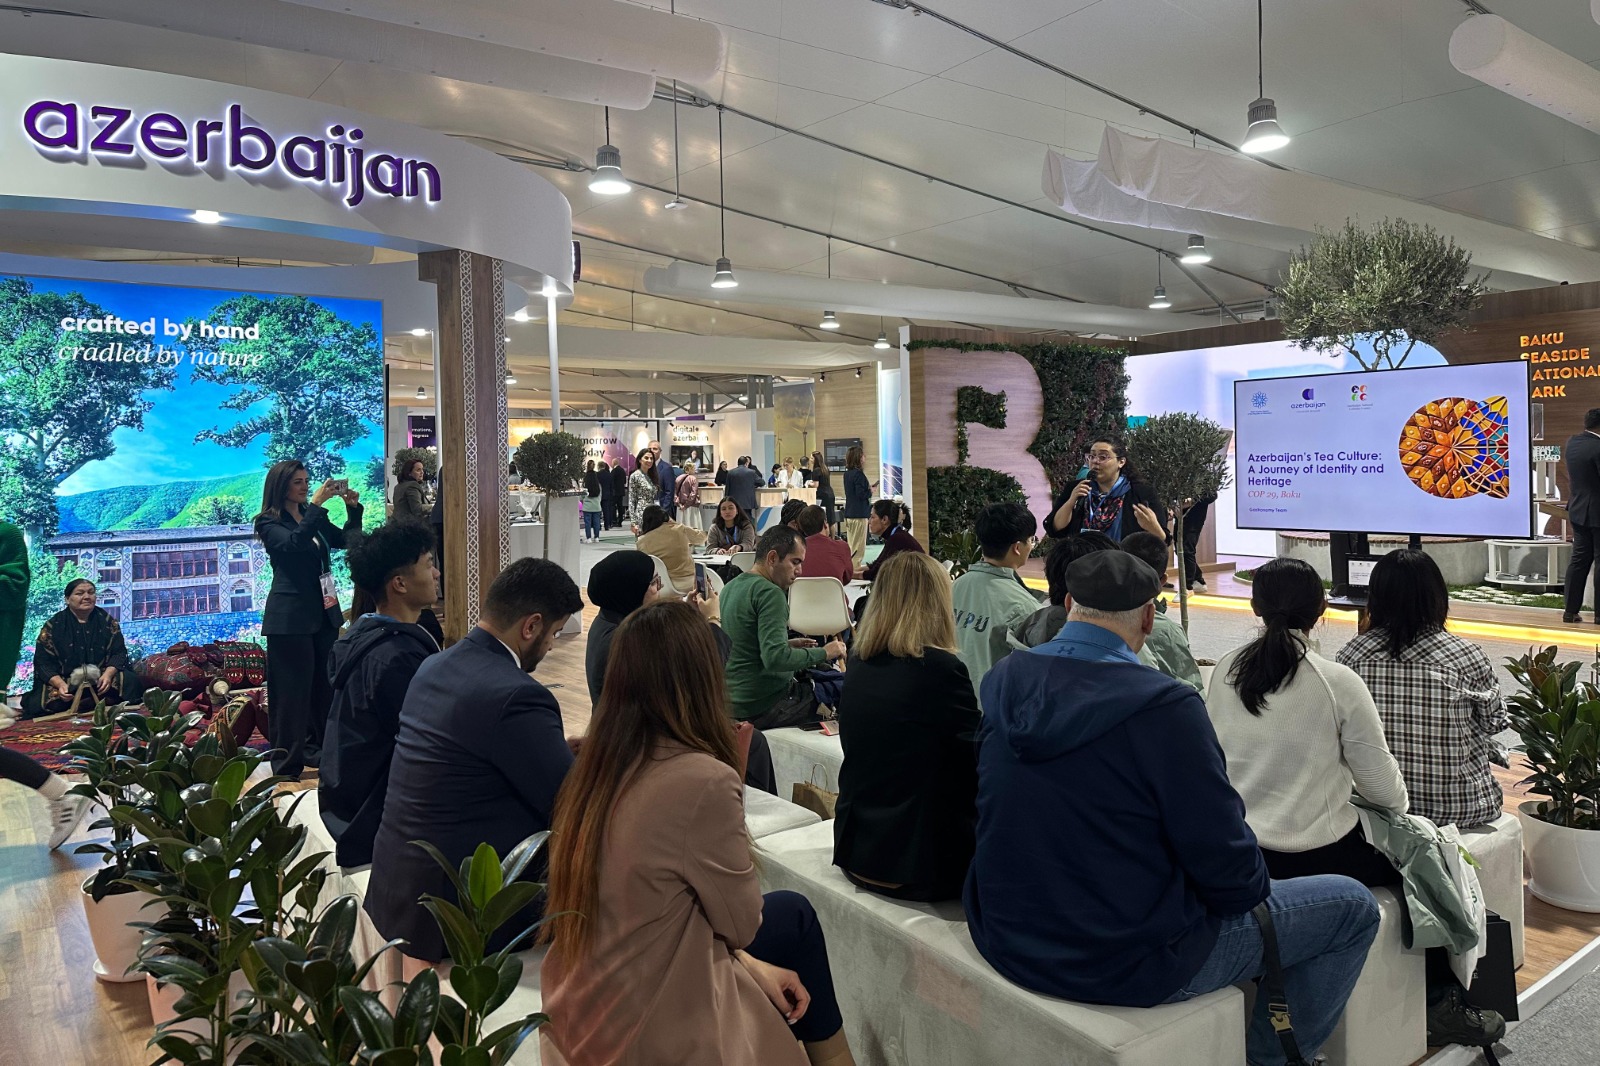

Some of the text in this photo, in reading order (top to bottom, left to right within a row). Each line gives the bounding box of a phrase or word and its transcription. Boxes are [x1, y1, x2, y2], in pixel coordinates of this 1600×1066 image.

[23, 100, 441, 206] azerbaijan
[60, 315, 260, 341] crafted by hand
[1520, 332, 1564, 347] BAKU
[58, 343, 264, 368] cradled by nature
[1532, 365, 1600, 381] ATIONA
[1531, 385, 1566, 398] ARK
[672, 425, 695, 434] digital
[582, 437, 618, 445] morrow
[672, 434, 709, 443] azerbain
[582, 447, 605, 459] oday
[1247, 451, 1382, 464] Azerbaijan's Tea Culture:
[1248, 463, 1384, 475] A Journey of Identity and
[1248, 477, 1292, 488] Heritage
[1248, 490, 1301, 499] COP 29, Baku
